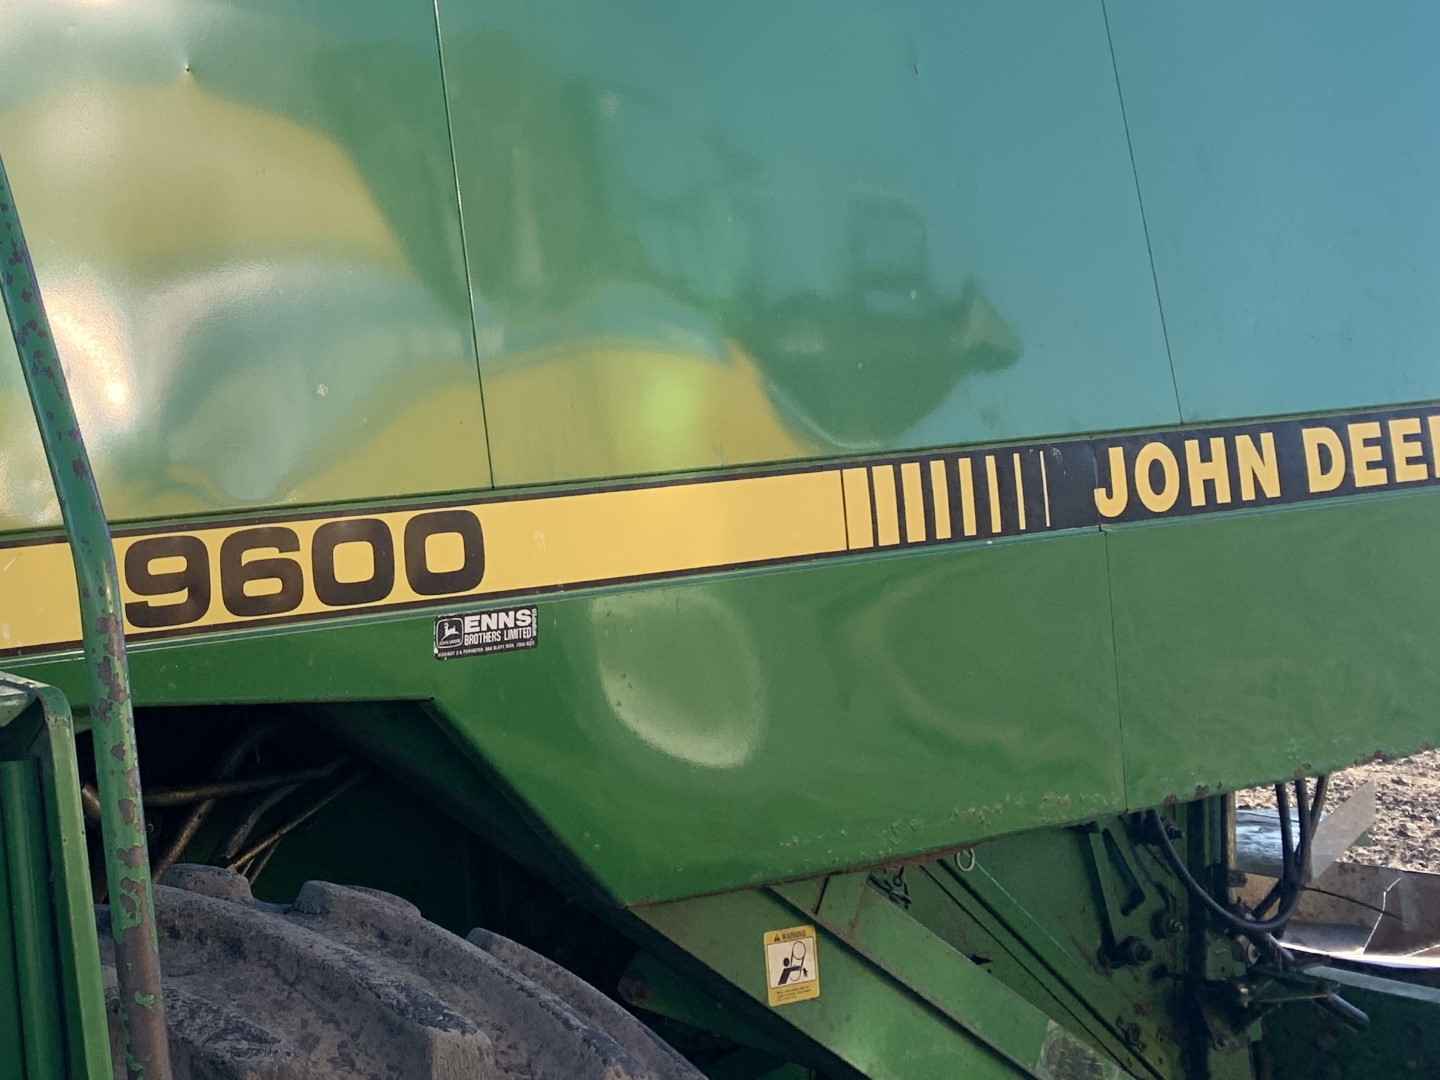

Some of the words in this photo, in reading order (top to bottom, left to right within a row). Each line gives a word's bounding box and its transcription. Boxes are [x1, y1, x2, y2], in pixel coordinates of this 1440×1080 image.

[1094, 432, 1281, 518] JOHN
[1302, 415, 1440, 493] DEE
[124, 509, 485, 627] 9600
[464, 608, 531, 633] ENNS
[464, 631, 501, 645] BROTHERS
[504, 626, 531, 641] LIMITED
[782, 930, 806, 940] WARNING
